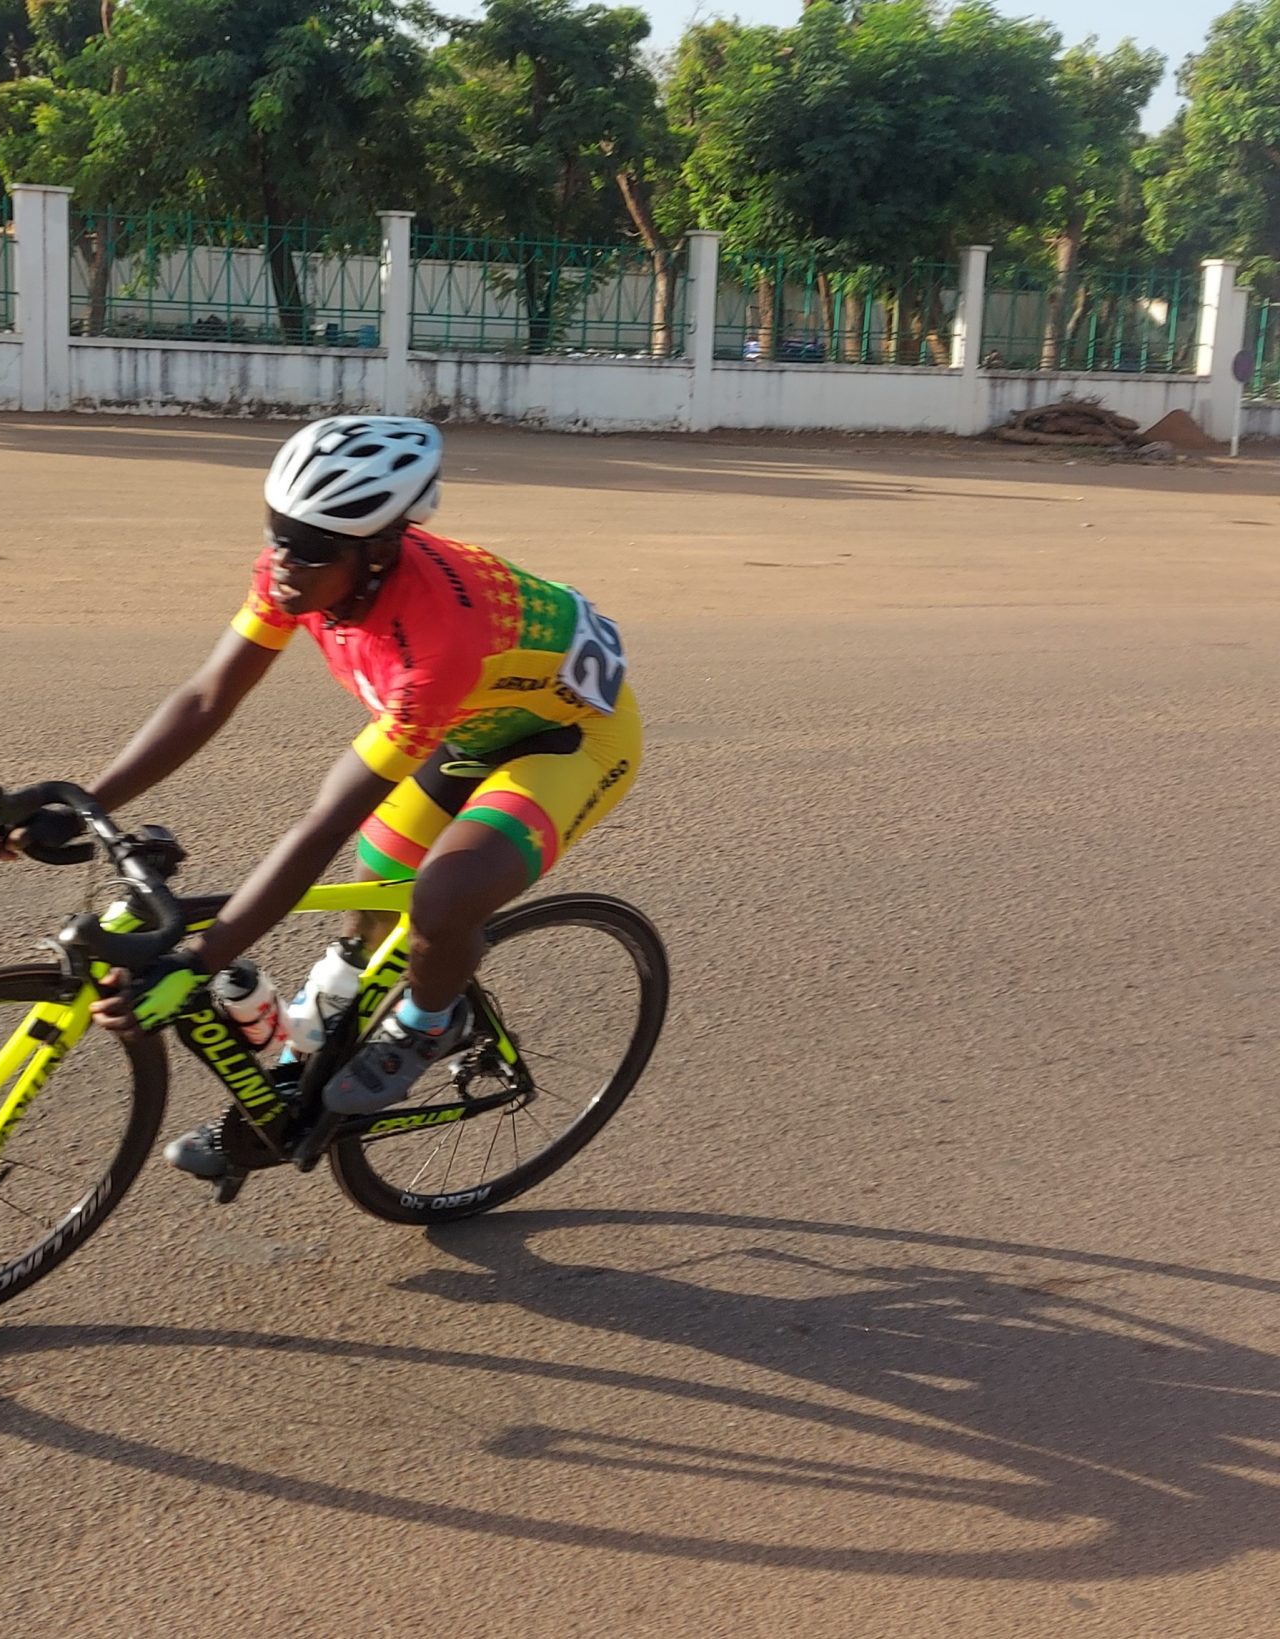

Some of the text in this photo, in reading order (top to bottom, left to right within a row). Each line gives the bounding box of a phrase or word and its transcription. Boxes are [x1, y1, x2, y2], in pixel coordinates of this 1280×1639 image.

[179, 1008, 277, 1108] POLLINI
[400, 1185, 493, 1210] AERO 40
